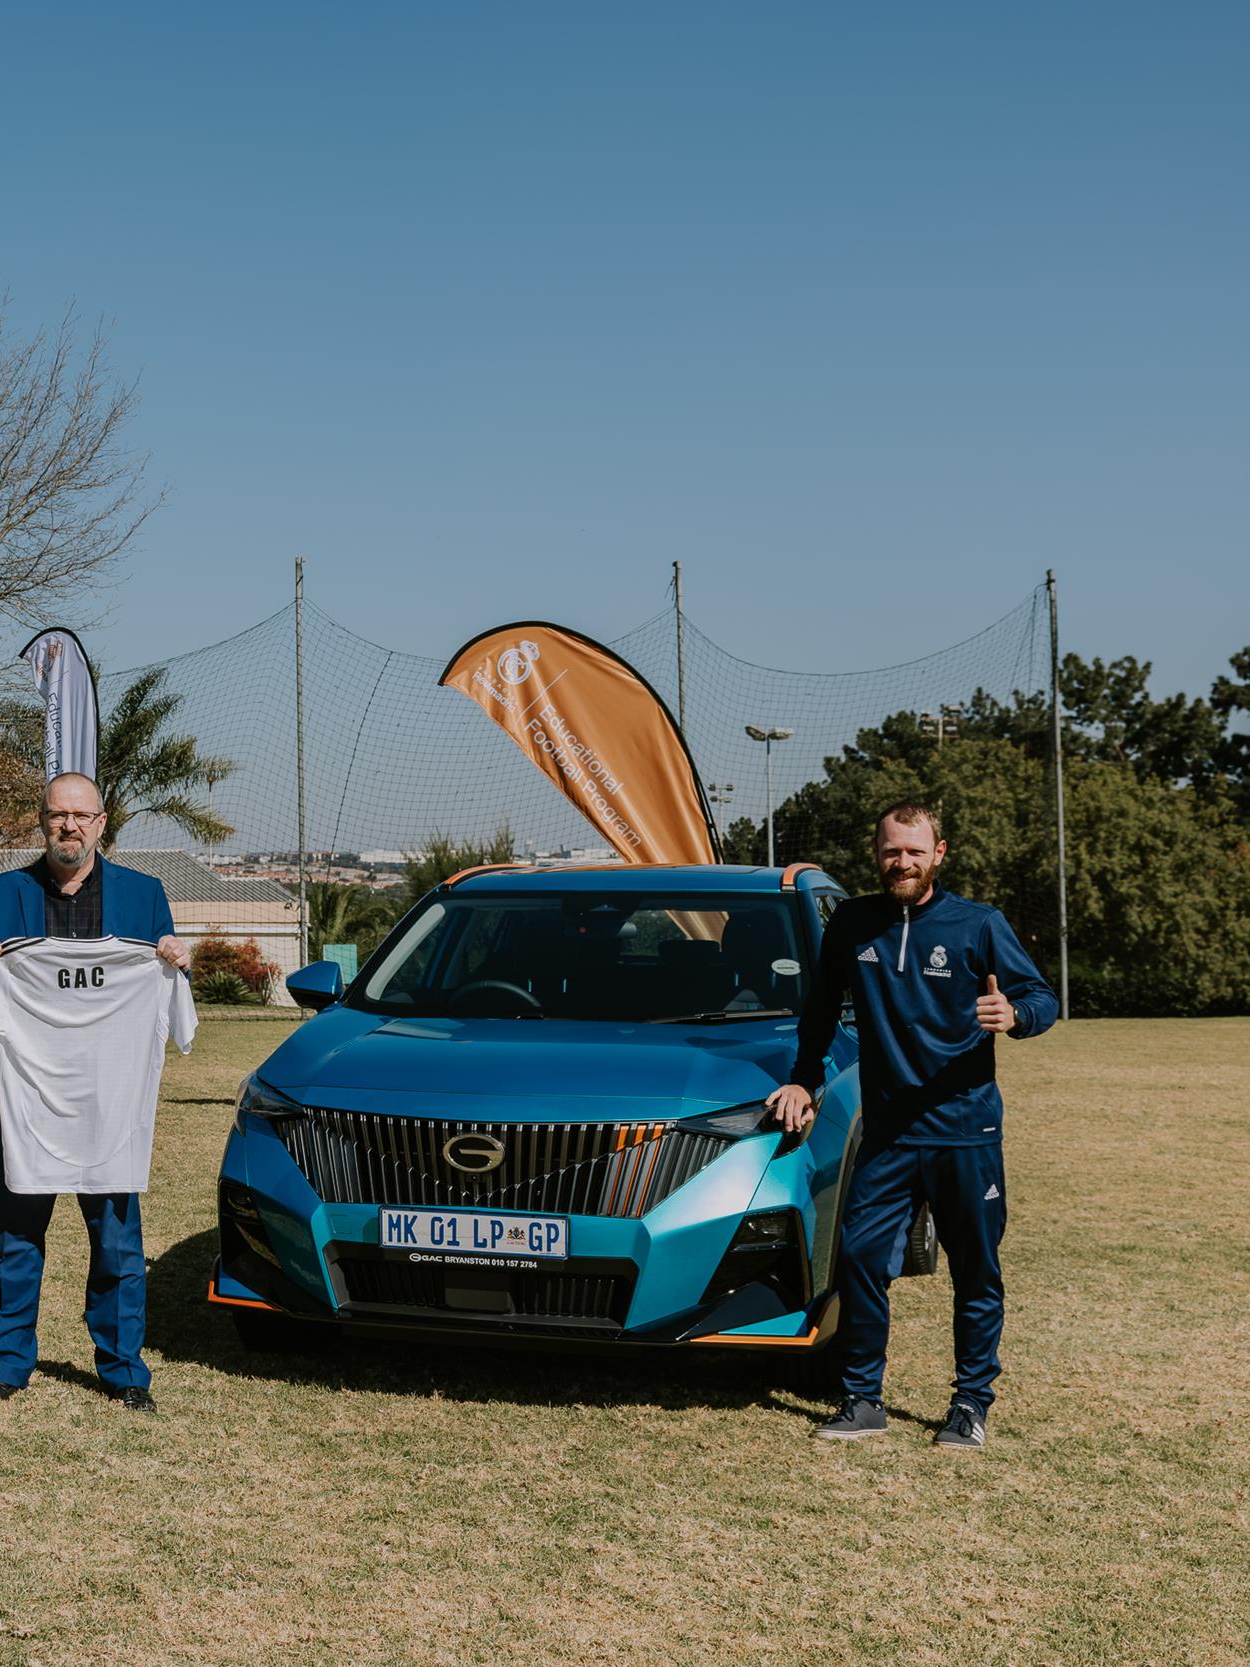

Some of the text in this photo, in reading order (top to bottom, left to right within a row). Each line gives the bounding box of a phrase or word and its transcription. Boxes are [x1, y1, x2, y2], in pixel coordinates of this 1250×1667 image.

[539, 703, 624, 796] Educational
[524, 718, 642, 847] Football Program
[58, 966, 105, 989] GAC
[387, 1213, 560, 1252] MK 01 LP GP
[444, 1255, 490, 1266] BRYANSTON
[491, 1258, 505, 1267] 010
[506, 1259, 519, 1268] 157
[520, 1260, 538, 1269] 2784
